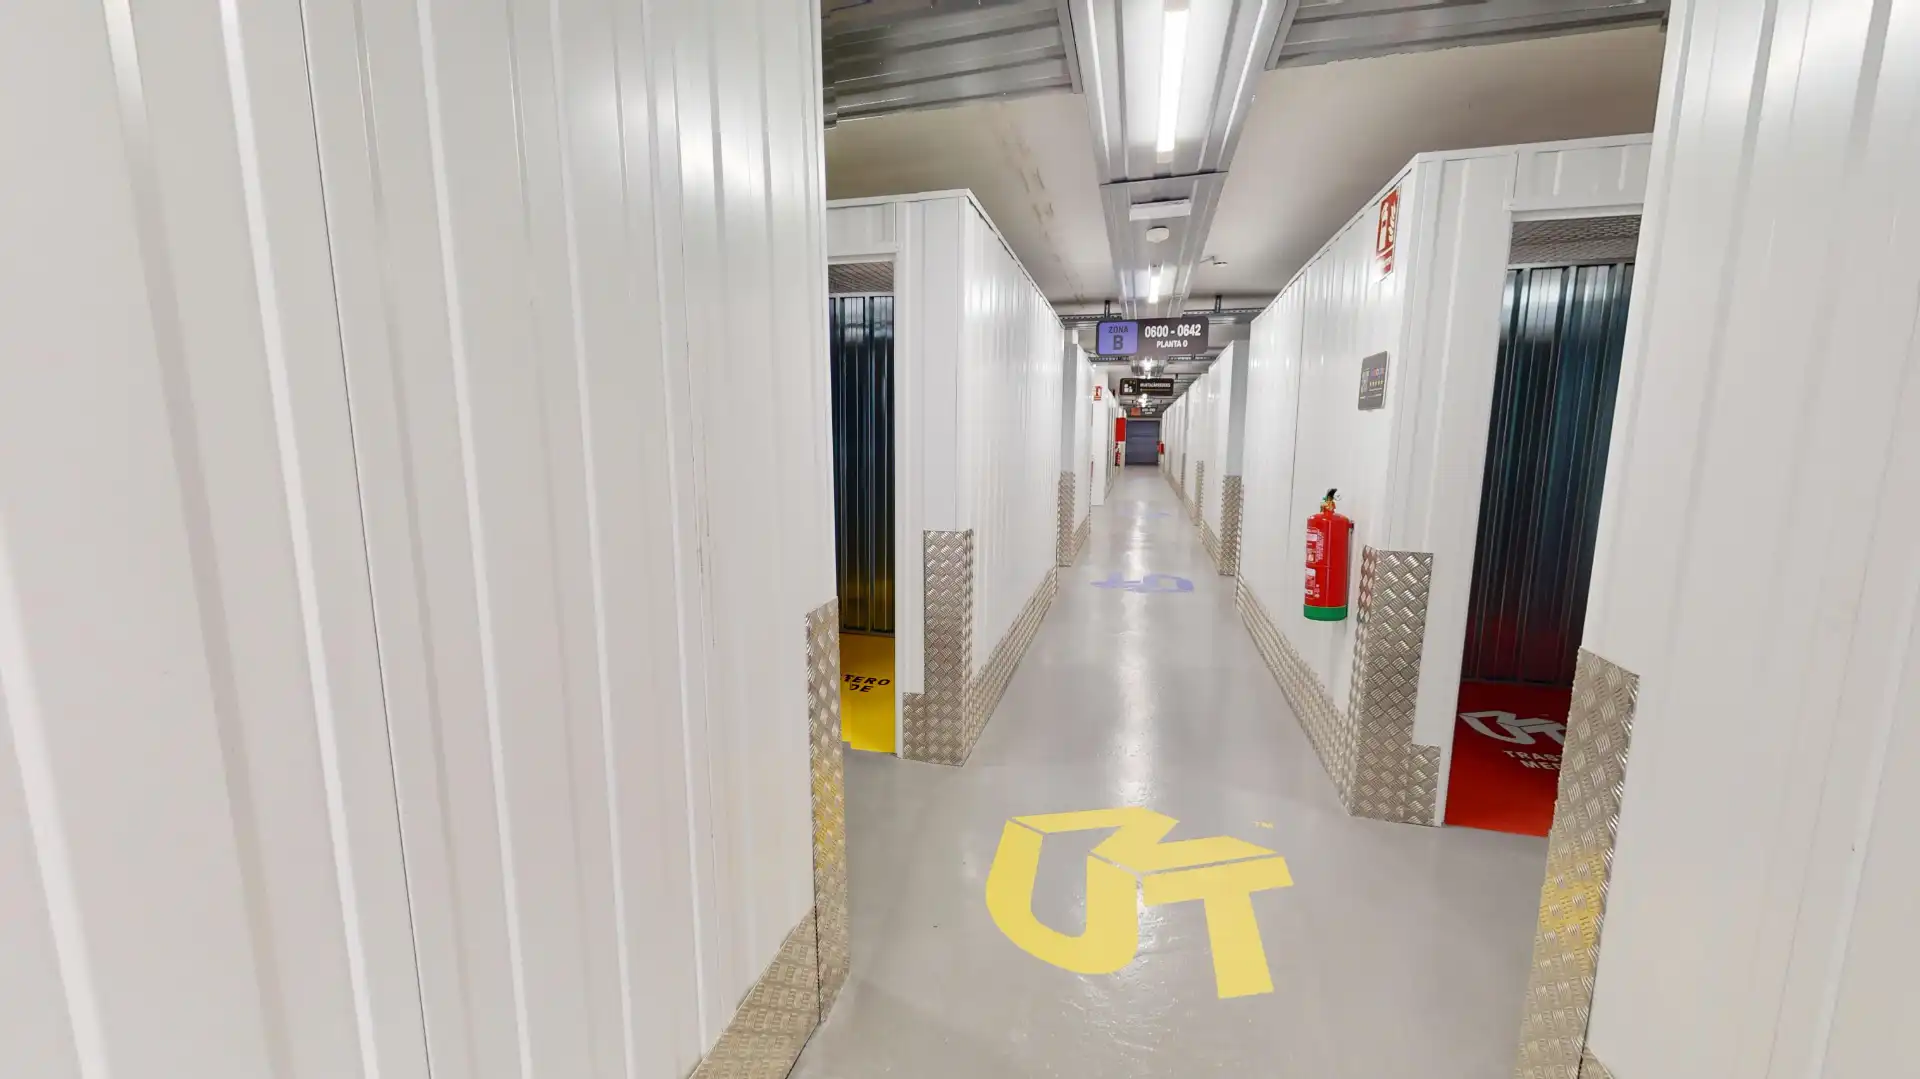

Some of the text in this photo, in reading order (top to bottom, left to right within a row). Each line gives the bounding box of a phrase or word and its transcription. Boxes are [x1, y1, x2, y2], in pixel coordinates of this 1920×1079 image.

[1108, 326, 1129, 334] ZONA
[1144, 325, 1169, 338] 0600
[1177, 324, 1202, 337] 0642
[1113, 335, 1124, 350] B
[1156, 340, 1181, 348] PLANTA
